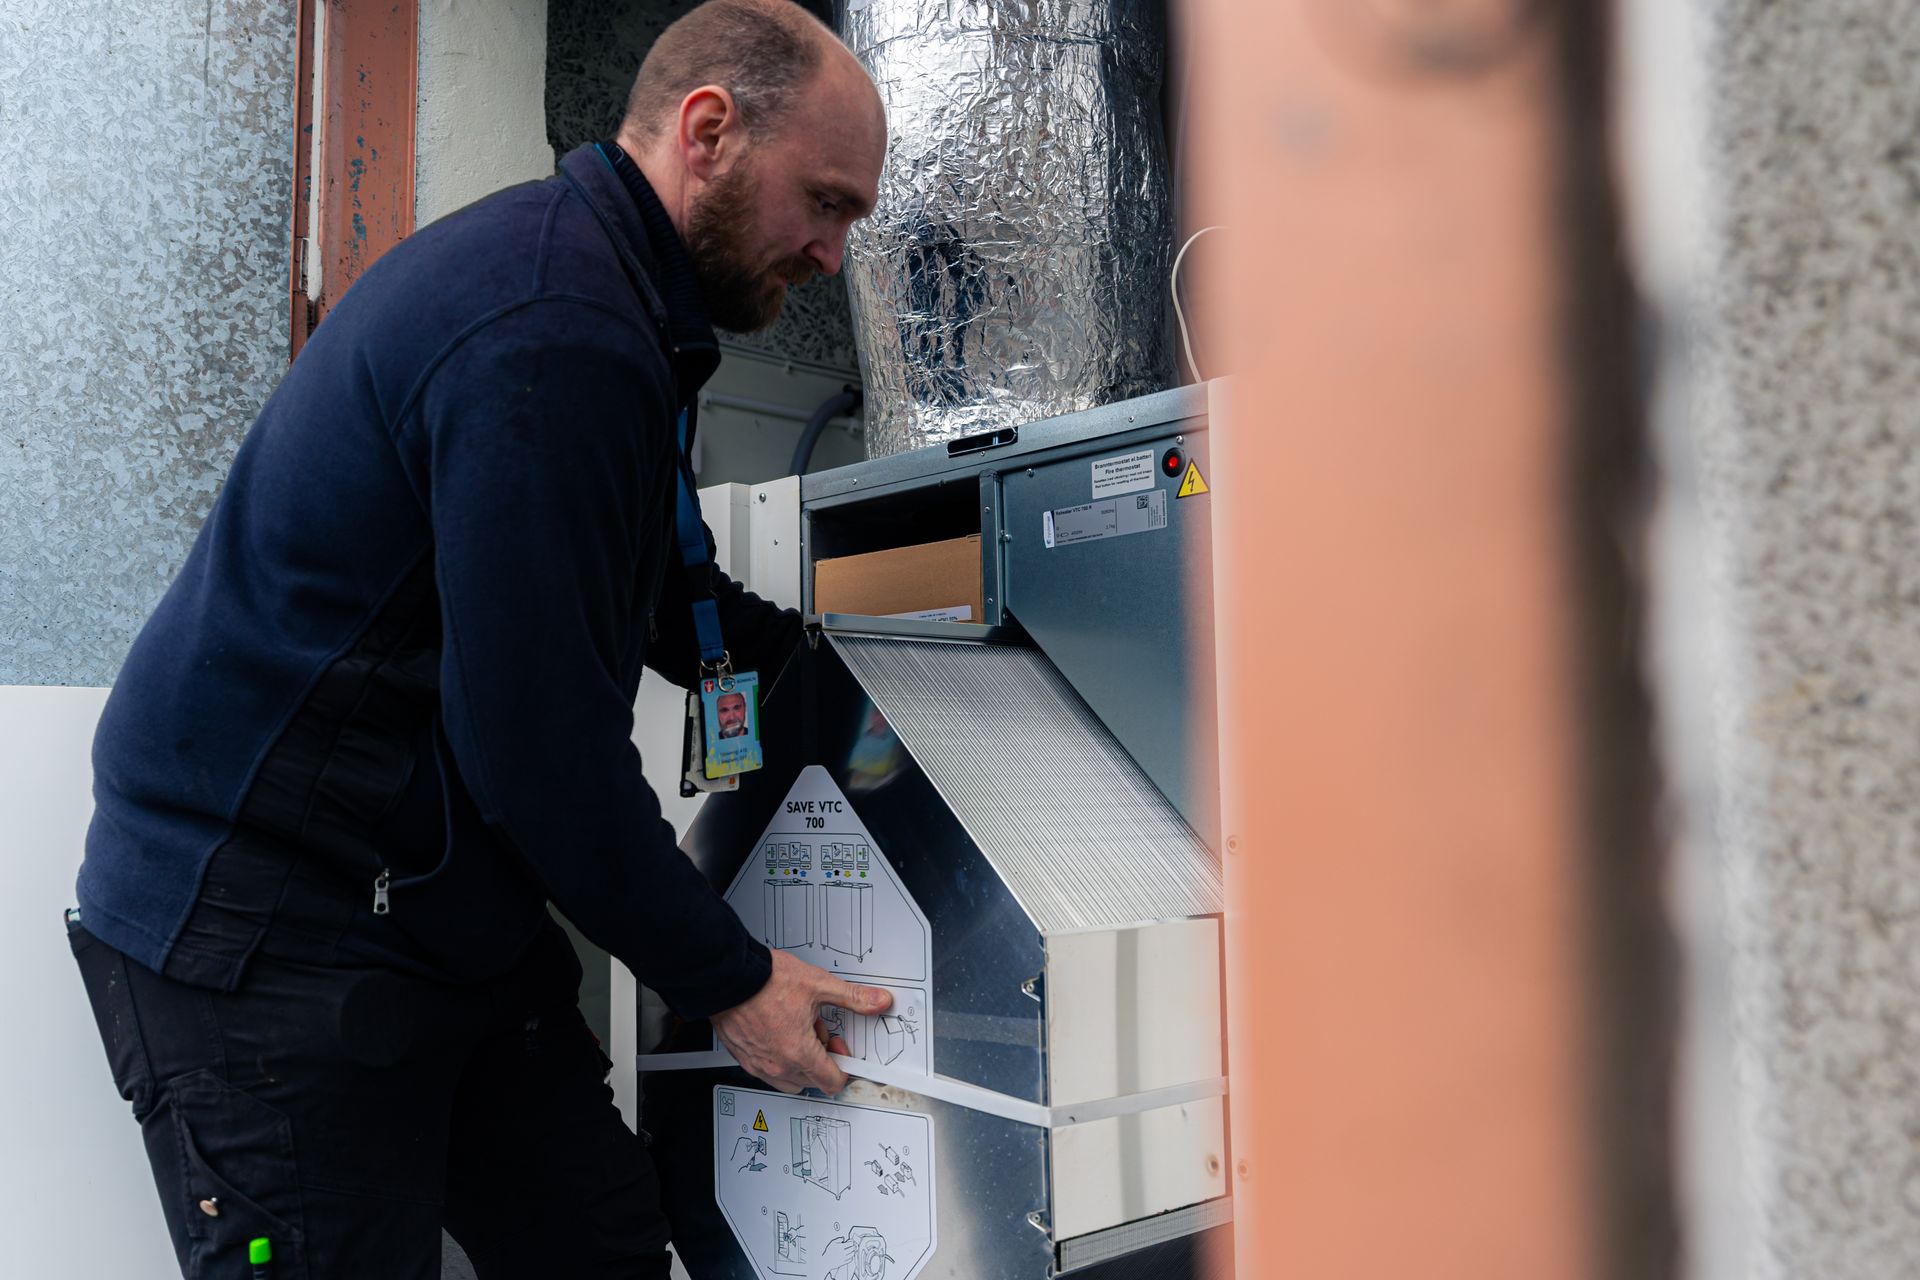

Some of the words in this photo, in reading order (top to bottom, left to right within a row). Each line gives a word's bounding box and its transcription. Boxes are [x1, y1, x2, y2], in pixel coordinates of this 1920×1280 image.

[1115, 463, 1141, 471] thermostat
[787, 801, 815, 813] SAVE
[819, 801, 842, 813] VTC
[805, 817, 825, 829] 700
